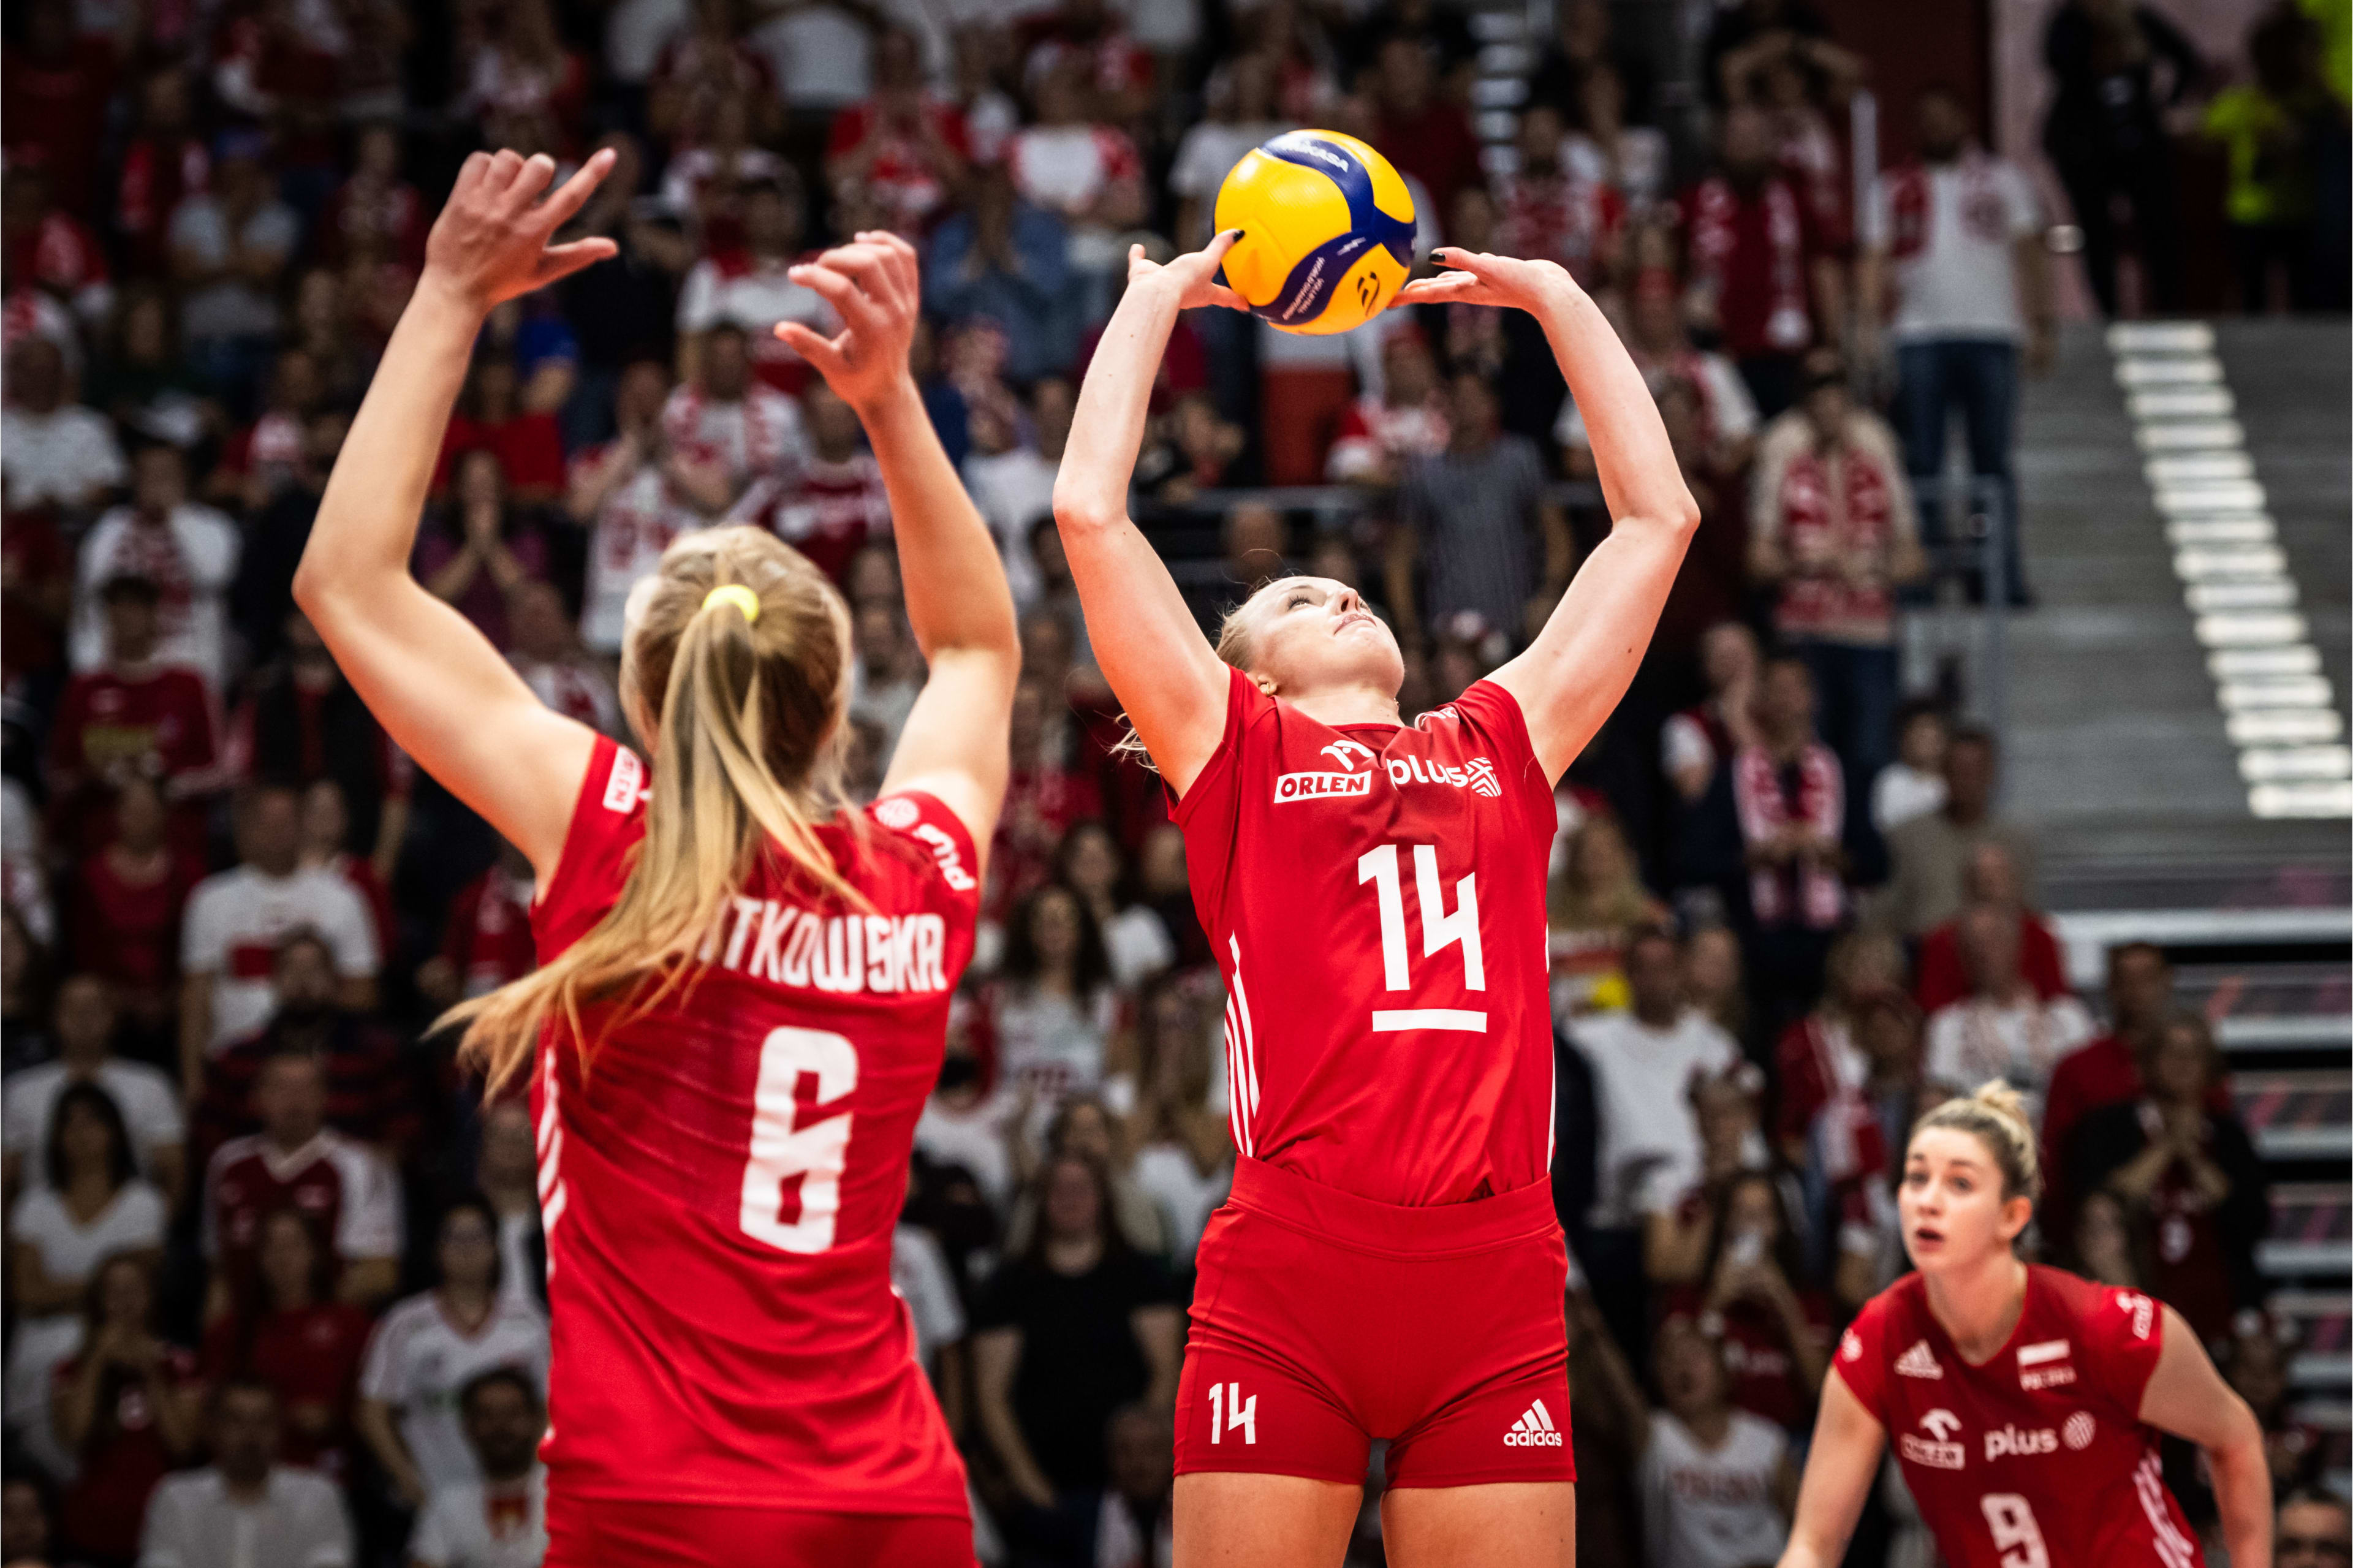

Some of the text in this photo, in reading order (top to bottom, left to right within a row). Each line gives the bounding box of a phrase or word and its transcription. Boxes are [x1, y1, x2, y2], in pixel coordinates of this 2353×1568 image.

[1280, 775, 1365, 797] ORLEN
[1385, 754, 1469, 790] plus
[1357, 844, 1486, 991] 14
[740, 1026, 858, 1254] 6
[1208, 1382, 1257, 1445] 14
[1503, 1429, 1563, 1447] adidas
[1984, 1423, 2059, 1462] plus
[1980, 1493, 2050, 1568] 9
